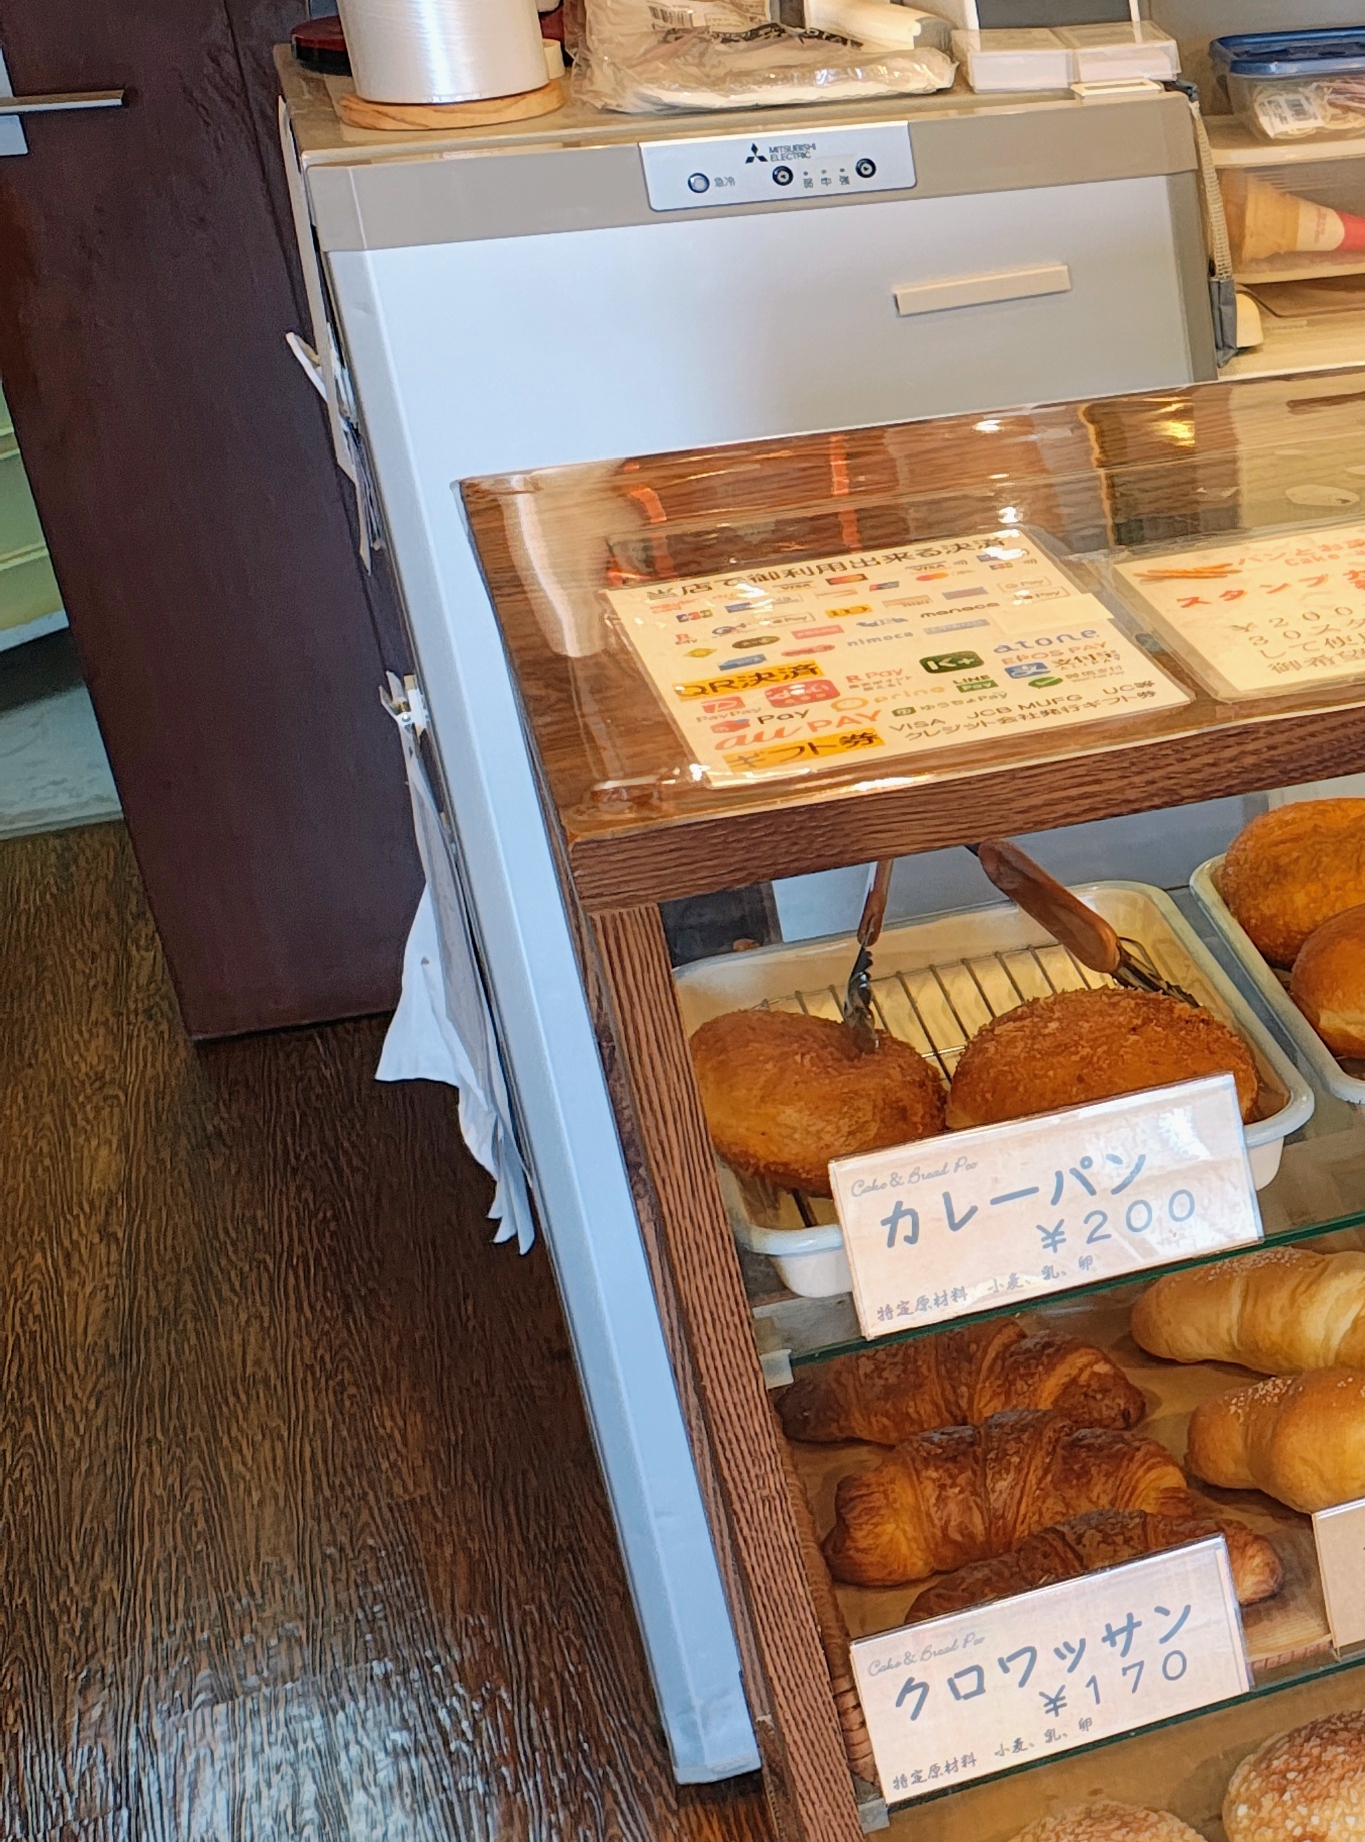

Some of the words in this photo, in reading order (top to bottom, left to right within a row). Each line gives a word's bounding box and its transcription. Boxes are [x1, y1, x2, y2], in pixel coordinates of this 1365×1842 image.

[769, 142, 817, 155] MITSUBISHI
[770, 151, 812, 163] ELECTRIC
[1284, 552, 1340, 568] Cake
[920, 601, 1001, 619] manaca
[846, 631, 914, 648] nimoca
[992, 628, 1098, 655] atone
[674, 661, 820, 698] QR決済
[951, 673, 991, 686] LINE
[695, 705, 762, 723] PayPay
[714, 724, 802, 751] au
[805, 708, 882, 733] PAY
[757, 708, 811, 726] Pay
[888, 717, 947, 733] VISA
[966, 706, 1014, 720] JCB
[1016, 693, 1084, 712] MUFG
[904, 688, 1158, 742] クレジット会社発行ギフト券
[727, 730, 880, 769] ギフト券
[850, 1178, 889, 1199] Cake
[907, 1160, 950, 1187] Bread
[880, 1153, 1148, 1250] カレーパン
[1035, 1188, 1197, 1254] ¥200
[877, 1286, 969, 1323] 特定原材料
[987, 1254, 1095, 1295] 小麦、乳、卵
[894, 1603, 1192, 1721] クロワッサン
[1038, 1648, 1188, 1718] ¥170
[892, 1751, 977, 1792] 特定原材料
[994, 1716, 1093, 1758] 小麦、乳、卵
